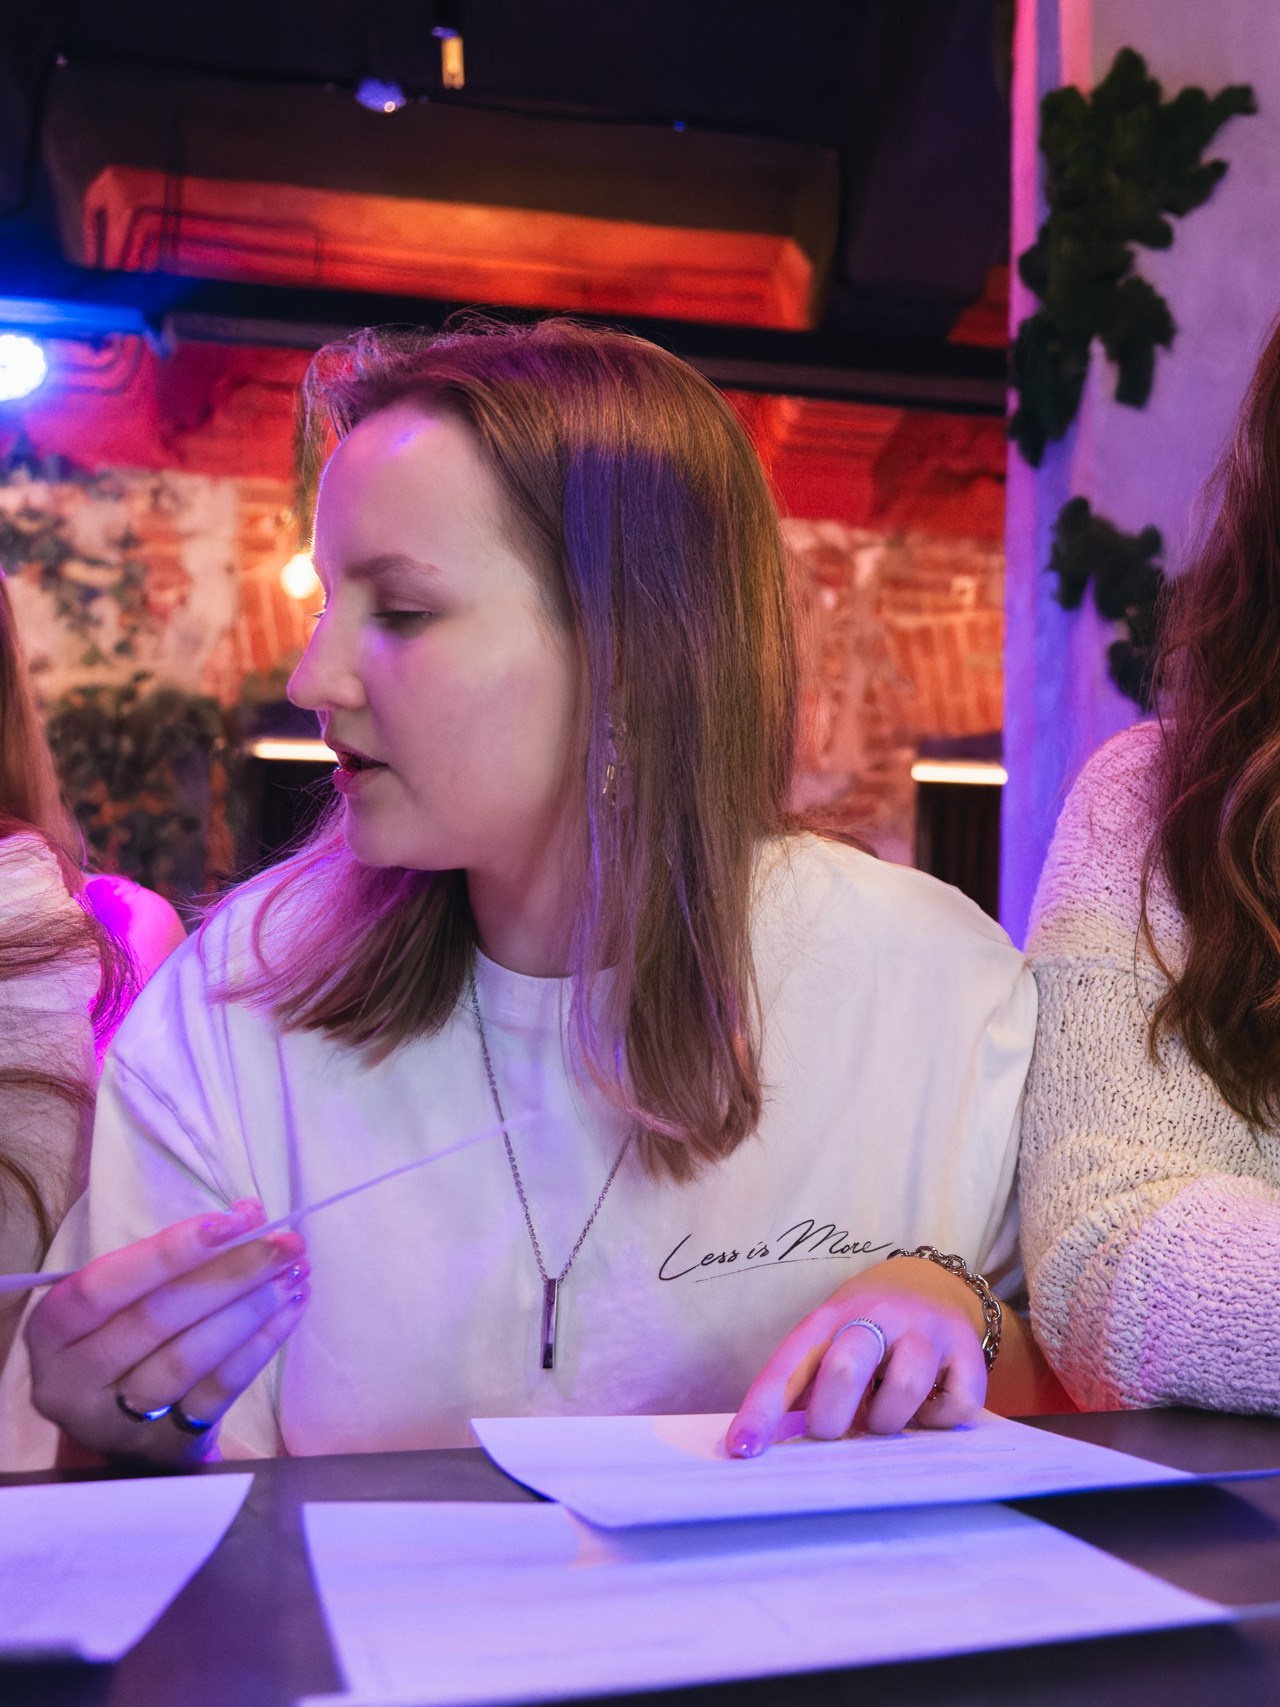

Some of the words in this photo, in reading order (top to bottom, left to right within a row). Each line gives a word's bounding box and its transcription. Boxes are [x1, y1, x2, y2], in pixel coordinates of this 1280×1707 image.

[658, 1233, 740, 1281] Less
[746, 1240, 770, 1260] is
[776, 1218, 894, 1260] More
